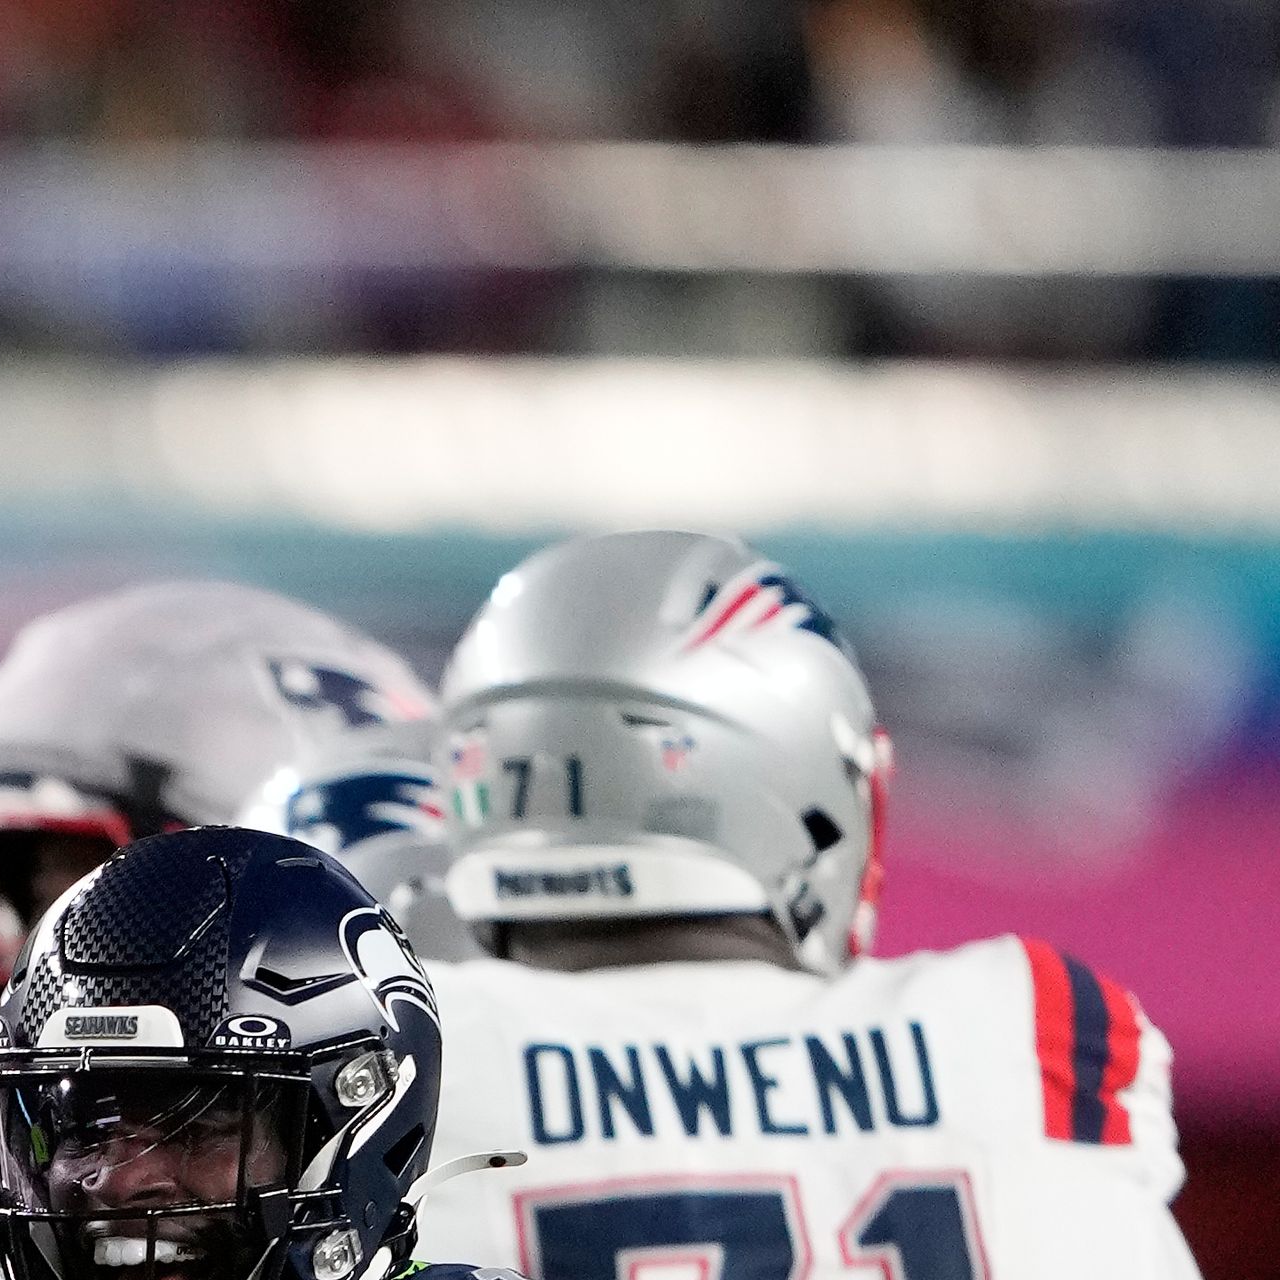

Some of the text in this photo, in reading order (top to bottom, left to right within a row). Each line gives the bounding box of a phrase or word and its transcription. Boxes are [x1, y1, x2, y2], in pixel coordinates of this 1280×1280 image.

[502, 752, 585, 820] 71
[64, 1015, 139, 1037] SEAHAWKS
[215, 1036, 287, 1048] OAKLEY
[522, 1020, 941, 1147] ONWENU
